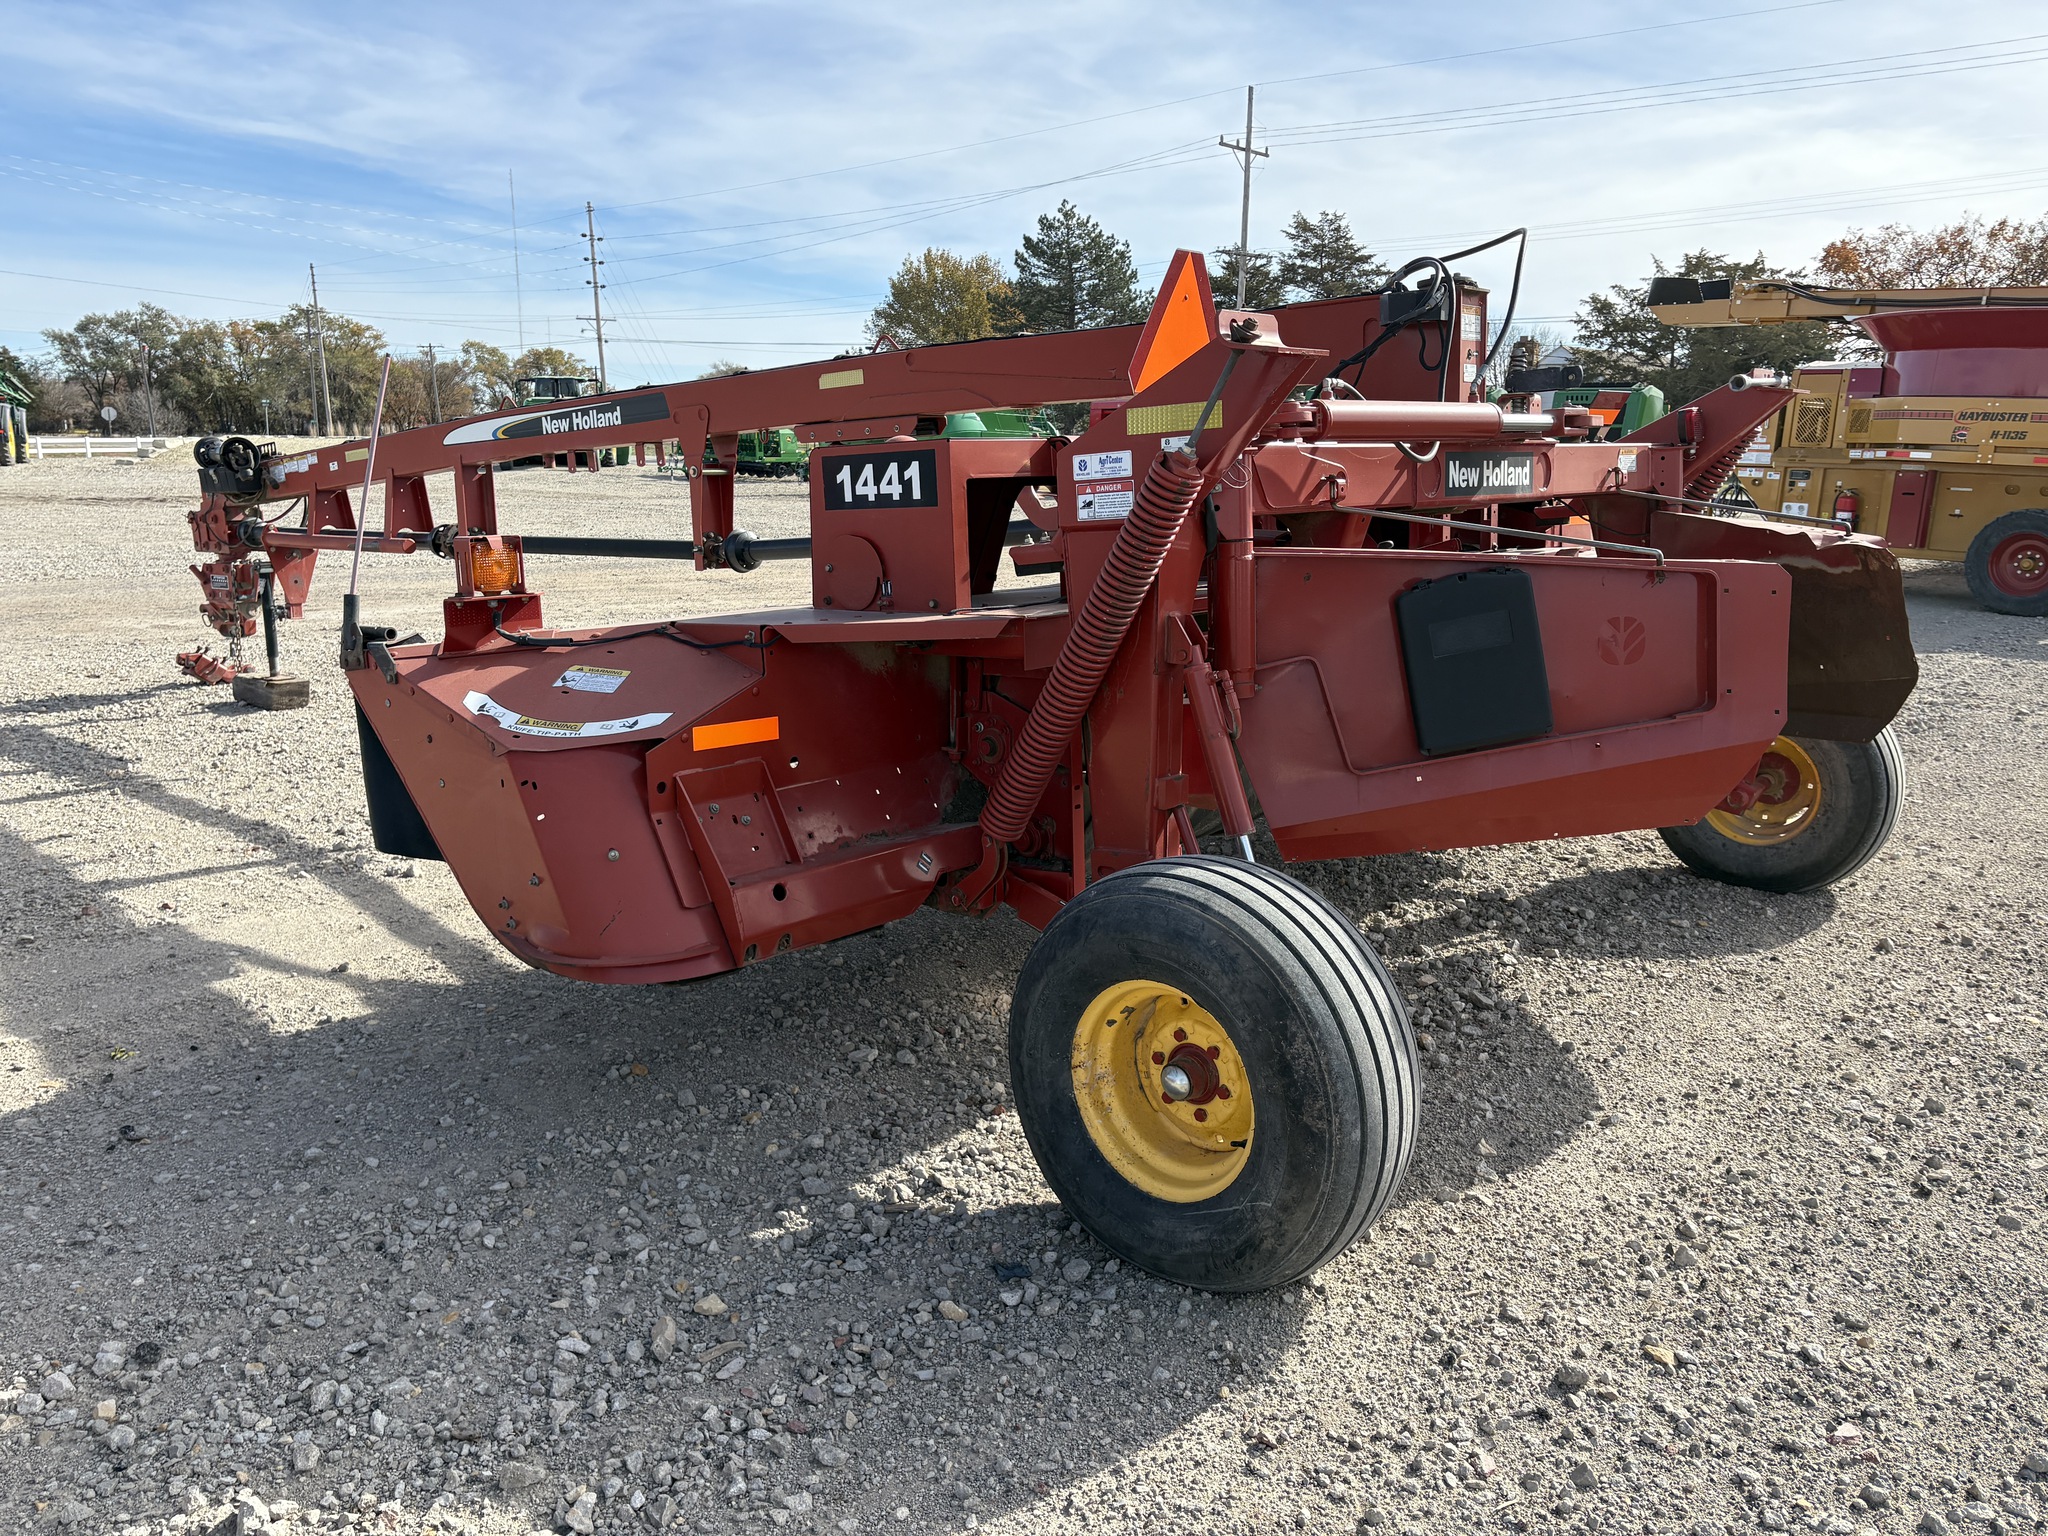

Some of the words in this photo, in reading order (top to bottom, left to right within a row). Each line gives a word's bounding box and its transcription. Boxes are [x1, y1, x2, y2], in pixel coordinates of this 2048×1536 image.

[541, 416, 569, 435] New
[572, 406, 622, 431] Holland
[1957, 411, 2029, 422] HAYBUSTER
[1990, 430, 2029, 440] H-1135
[1098, 455, 1109, 467] Agri
[1108, 455, 1123, 465] Center
[1449, 460, 1480, 488] New
[1483, 460, 1530, 487] Holland
[836, 460, 921, 502] 1441
[1095, 483, 1122, 492] DANGER
[588, 667, 624, 676] WARNING
[507, 723, 582, 737] KNIFE-TIP-PATH
[532, 719, 579, 731] WARNING
